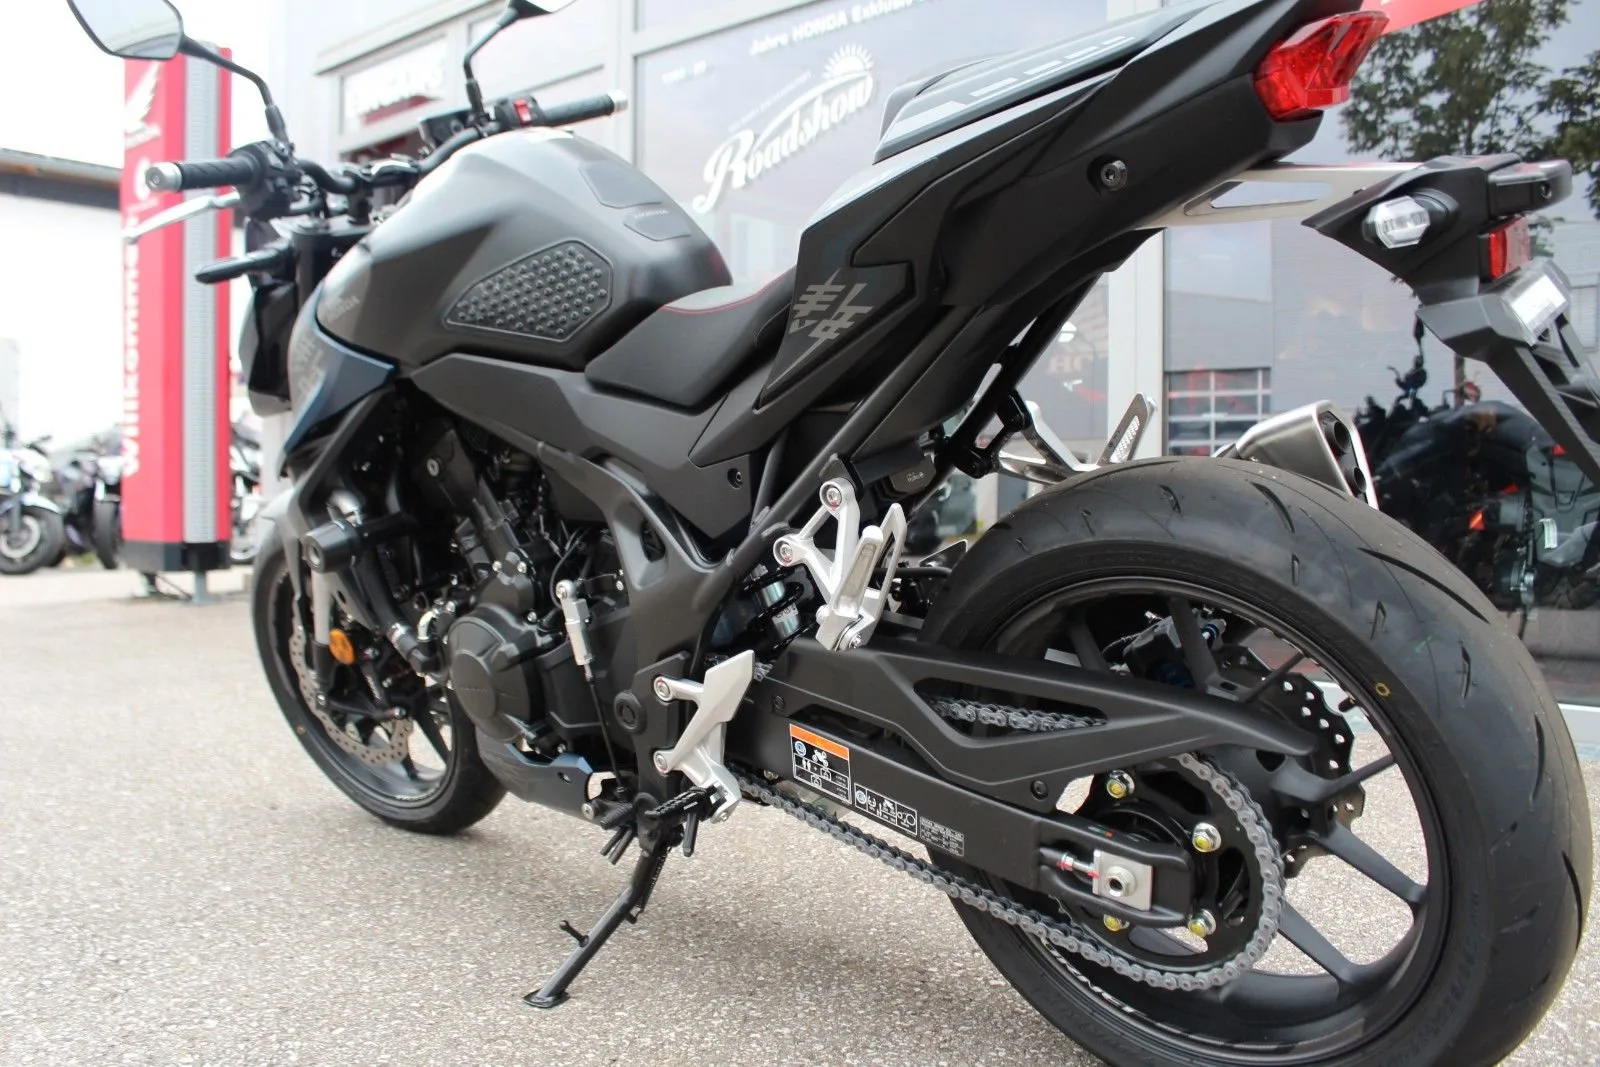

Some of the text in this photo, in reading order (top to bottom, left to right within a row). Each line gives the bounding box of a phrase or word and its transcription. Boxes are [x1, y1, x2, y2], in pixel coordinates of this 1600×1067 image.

[749, 31, 790, 55] Jahre
[791, 9, 848, 41] HONDA
[692, 70, 875, 214] Roadshow
